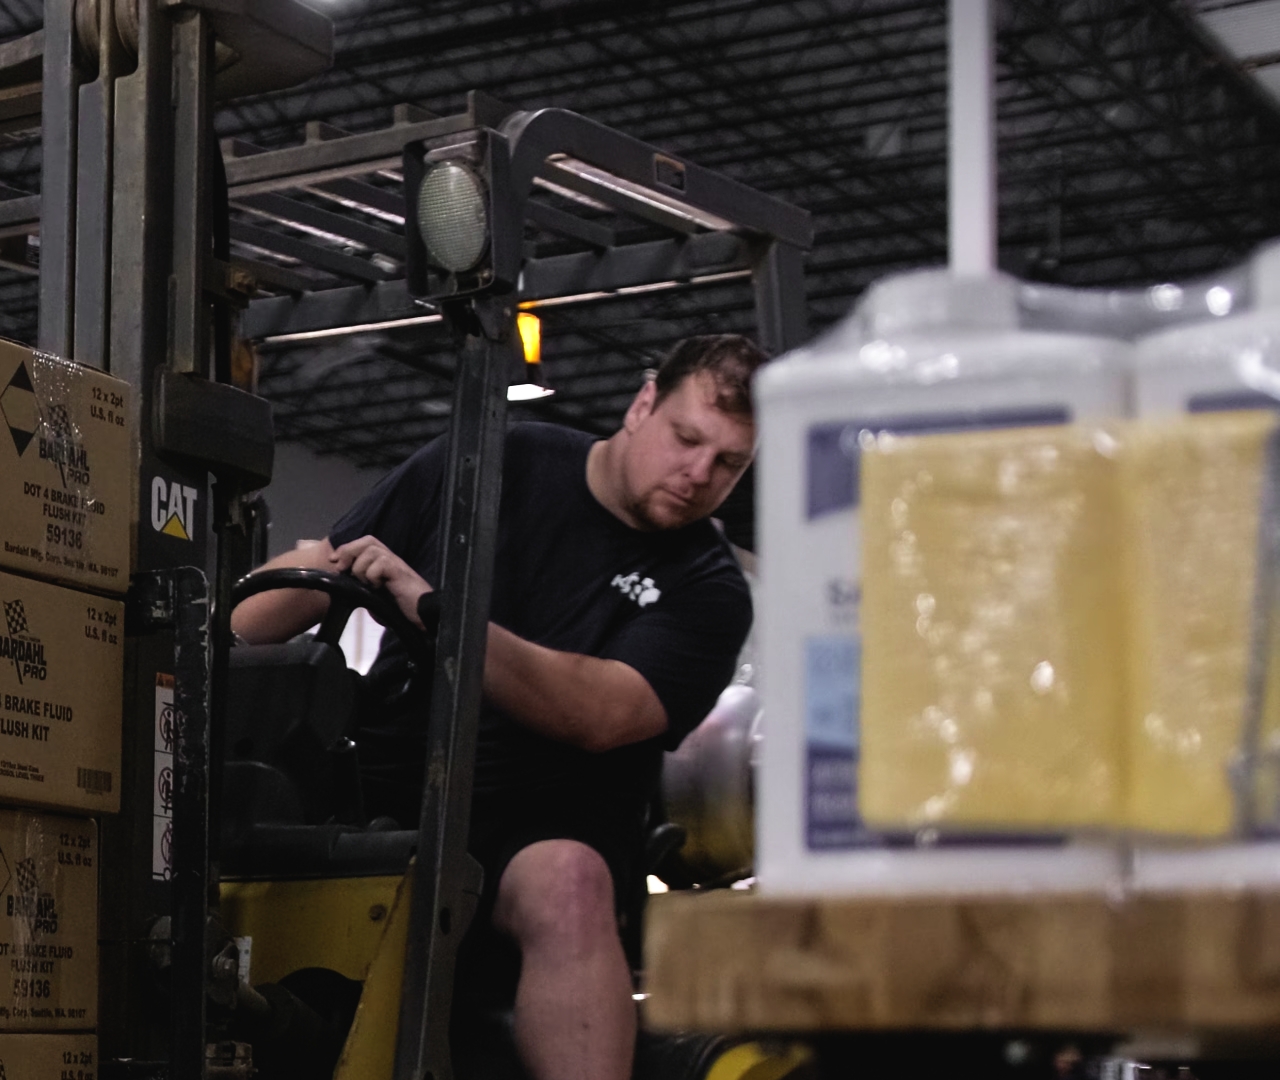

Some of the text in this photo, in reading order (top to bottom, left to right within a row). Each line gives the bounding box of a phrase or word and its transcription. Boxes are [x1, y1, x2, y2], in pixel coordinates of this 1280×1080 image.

[151, 476, 198, 541] CAT
[46, 523, 82, 549] 59136
[23, 663, 46, 680] PRO
[13, 979, 49, 997] 59136
